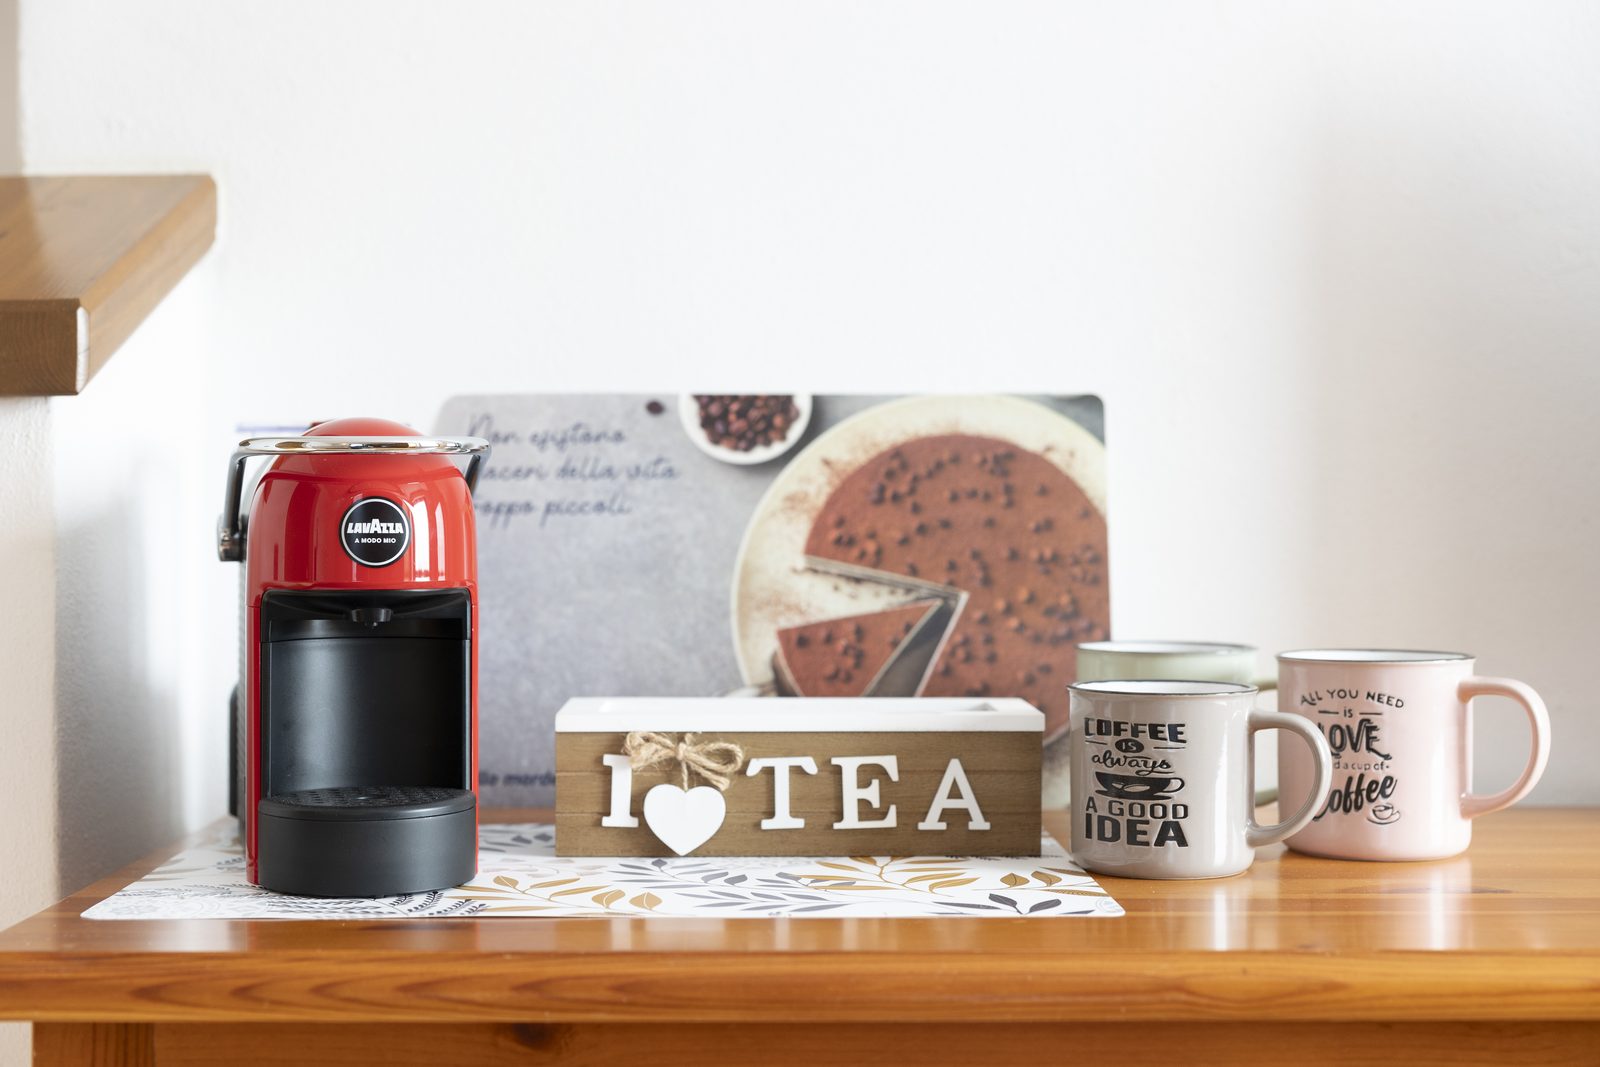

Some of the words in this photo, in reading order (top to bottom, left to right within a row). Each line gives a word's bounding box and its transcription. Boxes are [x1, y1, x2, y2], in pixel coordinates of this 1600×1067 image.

[346, 518, 404, 534] LAVAZZA
[1301, 690, 1323, 706] ALL
[1327, 688, 1359, 699] YOU
[1365, 690, 1404, 709] NEED
[1084, 717, 1187, 743] COFFEE
[1121, 741, 1138, 751] IS
[1091, 749, 1175, 777] always
[1351, 762, 1371, 771] cup
[745, 754, 991, 831] TEA
[1312, 772, 1399, 822] offee
[1085, 796, 1098, 813] A
[1108, 800, 1189, 820] GOOD
[1085, 812, 1189, 848] IDEA
